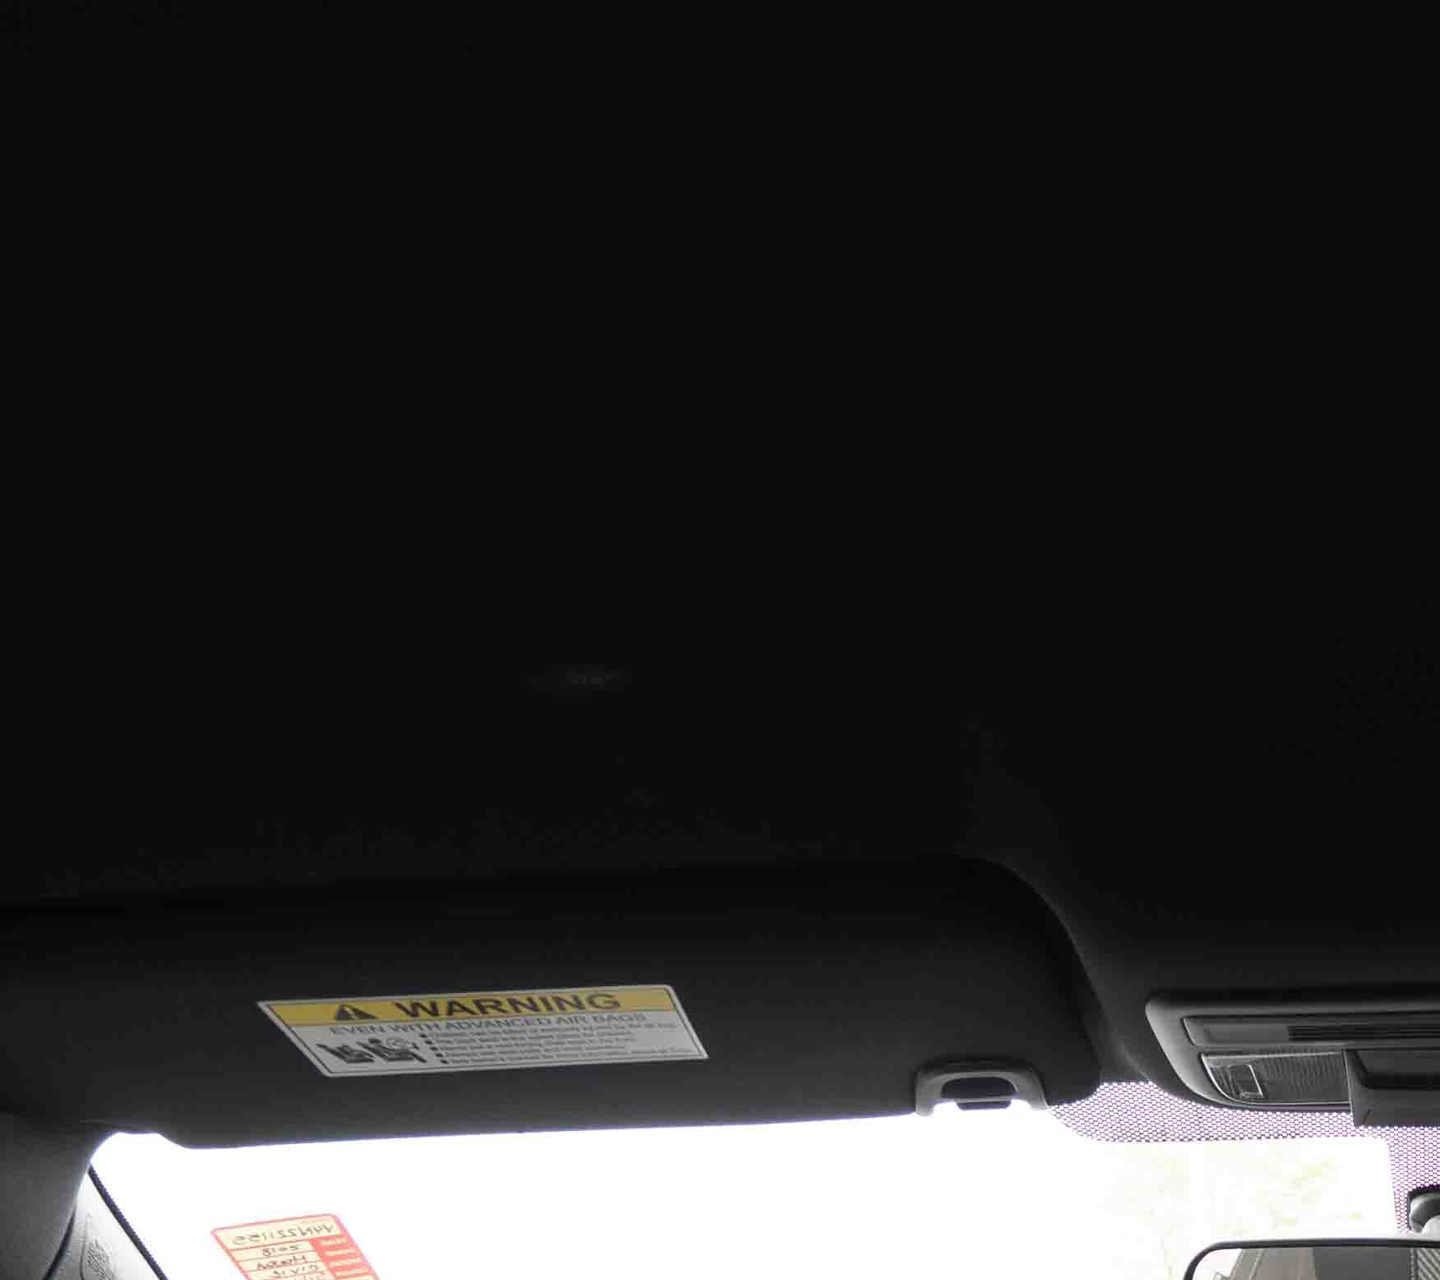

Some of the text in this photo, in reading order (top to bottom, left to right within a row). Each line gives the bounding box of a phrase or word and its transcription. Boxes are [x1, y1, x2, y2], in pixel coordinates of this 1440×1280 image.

[394, 993, 622, 1019] WARNING
[330, 1024, 386, 1036] EVEN
[445, 1016, 551, 1031] ADVANCED
[556, 1014, 592, 1025] AIR
[593, 1012, 648, 1023] BAGS
